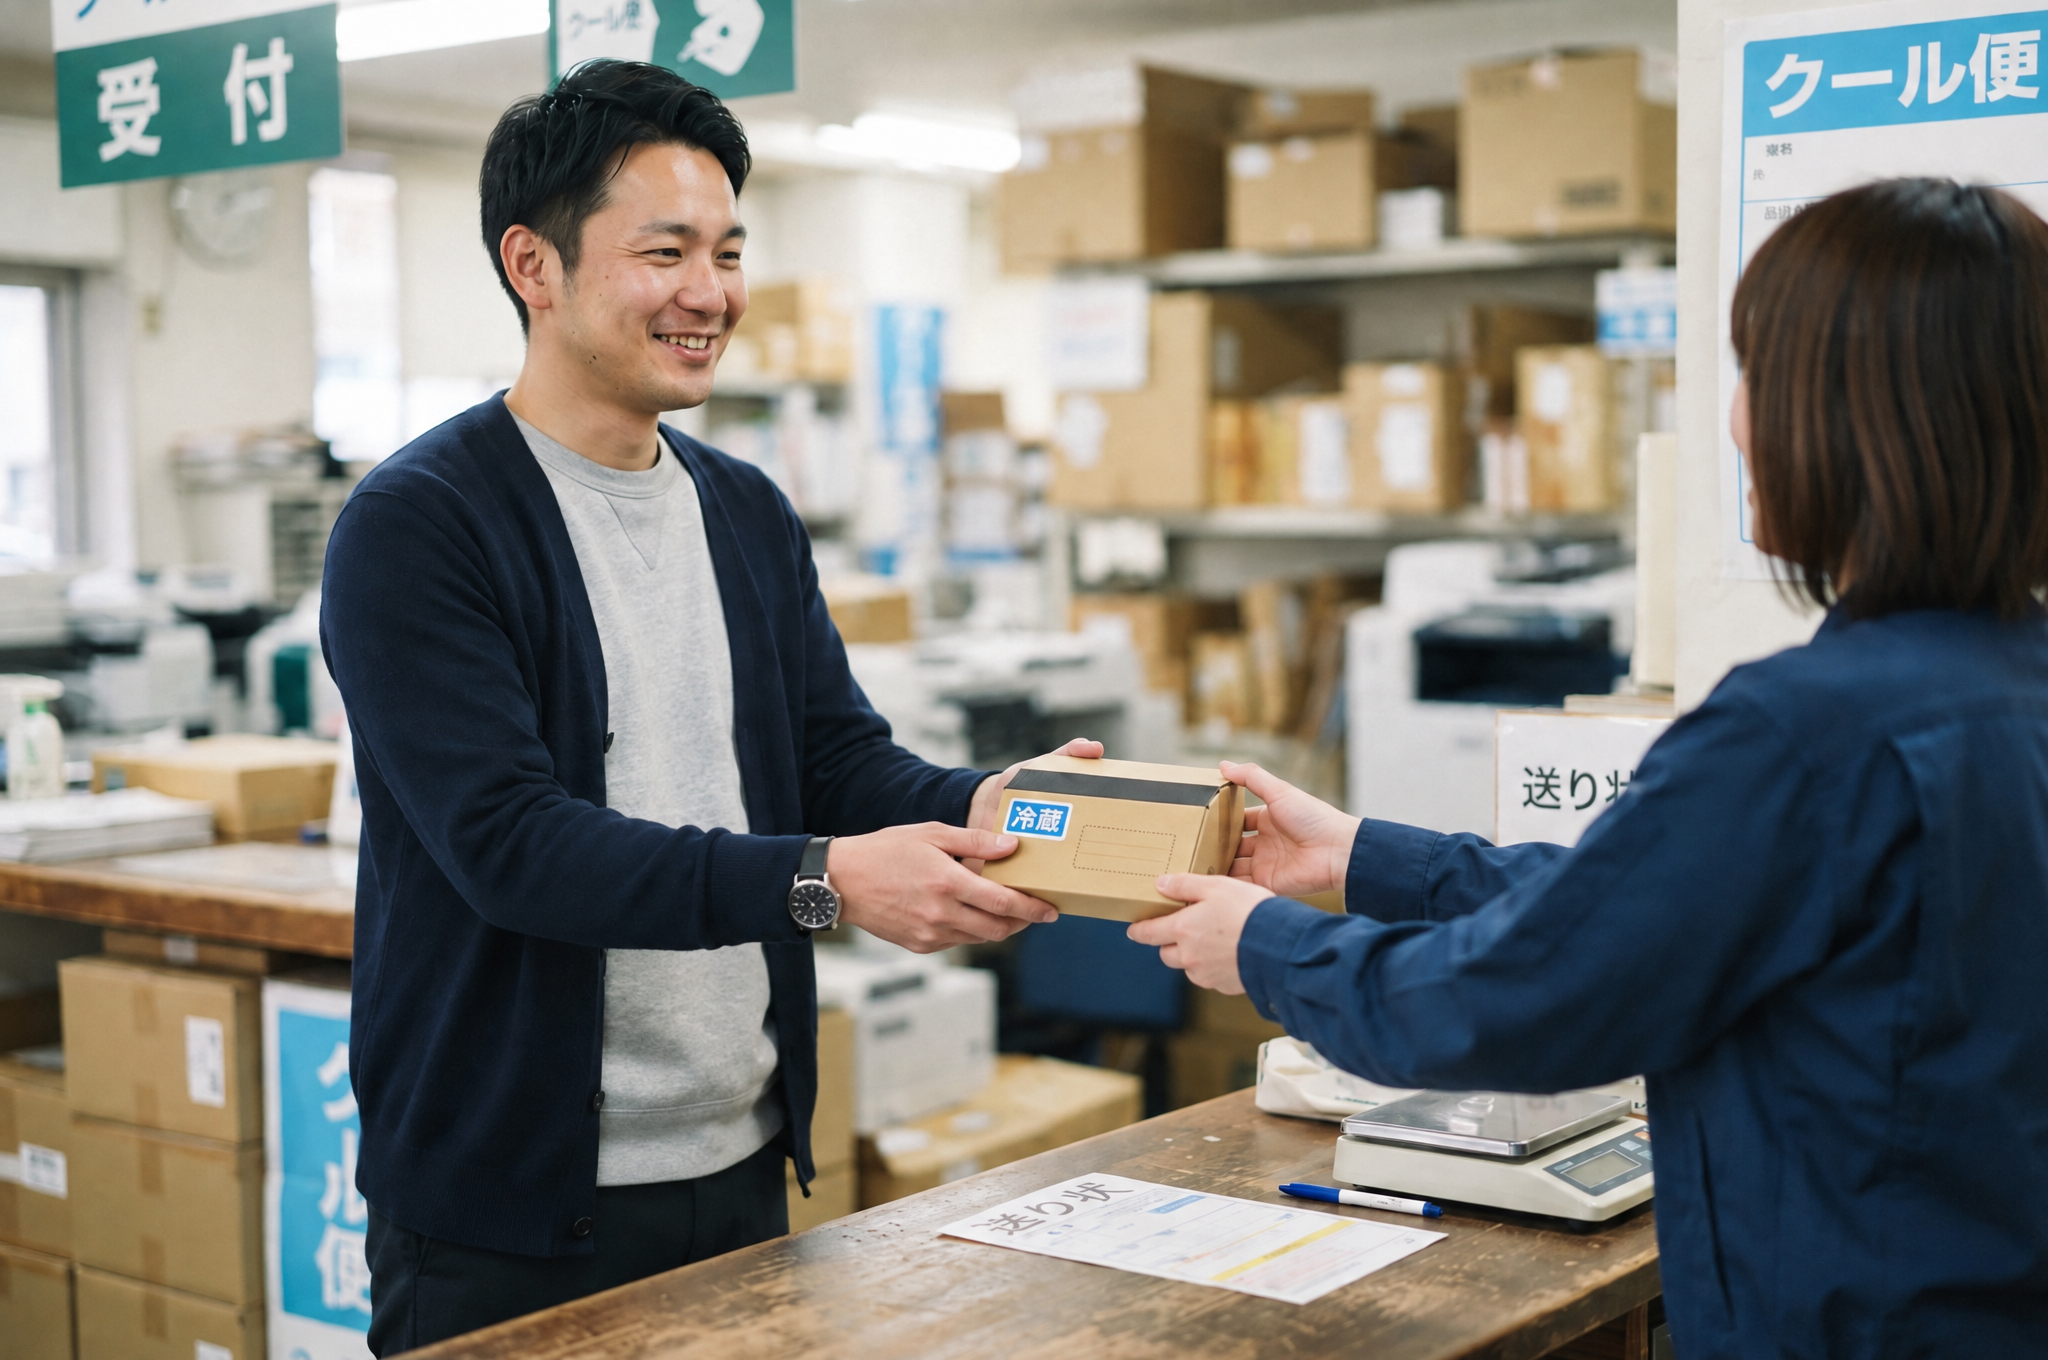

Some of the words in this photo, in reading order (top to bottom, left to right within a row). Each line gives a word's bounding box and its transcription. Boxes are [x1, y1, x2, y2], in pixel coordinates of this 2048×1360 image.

[97, 36, 294, 162] 受付
[1765, 29, 2041, 118] クール便
[1011, 806, 1064, 833] 冷蔵
[971, 1182, 1135, 1236] 送り状
